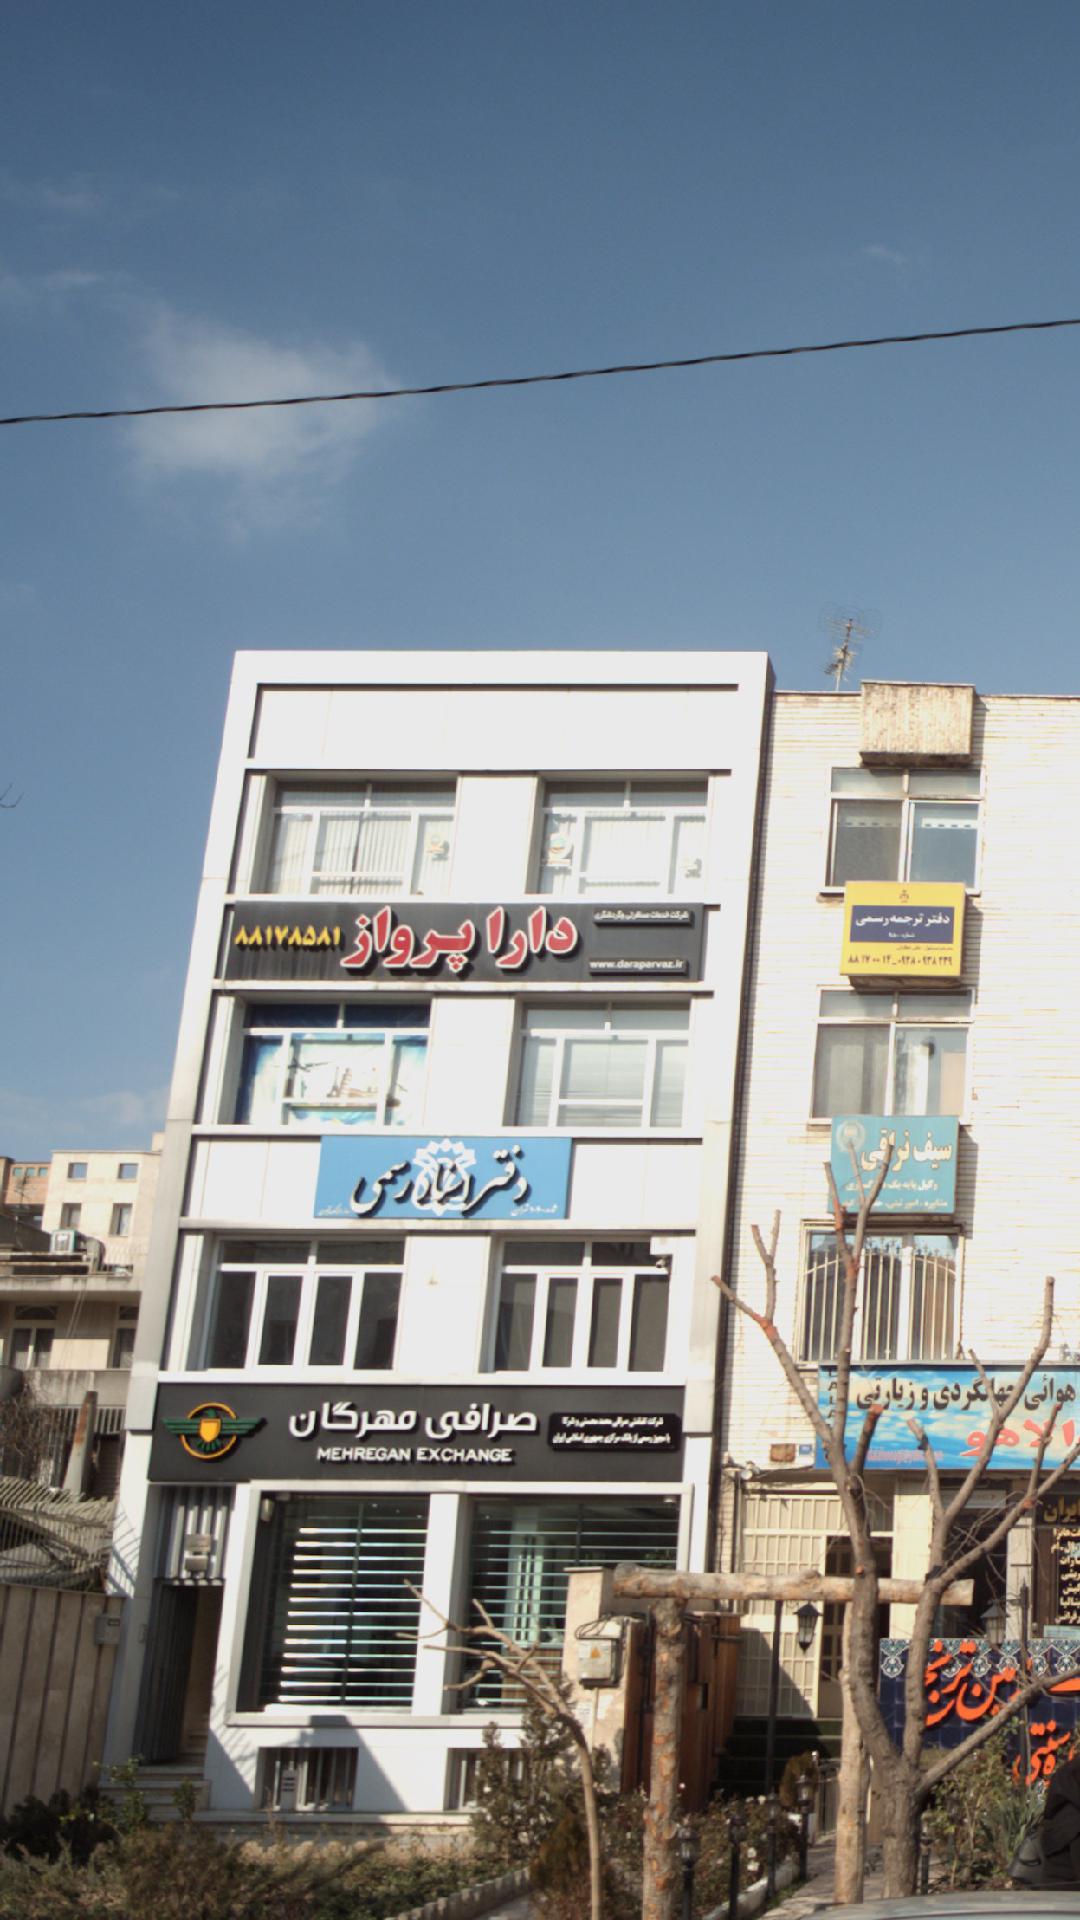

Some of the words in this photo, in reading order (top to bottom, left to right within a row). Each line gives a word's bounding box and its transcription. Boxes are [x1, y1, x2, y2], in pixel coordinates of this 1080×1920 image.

[234, 925, 341, 947] ۸۸۱۷۸۵۸۱
[487, 905, 577, 969] دارا
[855, 914, 889, 927] رسمی
[890, 912, 925, 927] ترجمه
[924, 911, 951, 928] دفتر
[341, 905, 475, 973] پرواز
[589, 959, 684, 971] www.daraparvaz.ir
[912, 1132, 952, 1169] سیف
[350, 1159, 410, 1216] رسمی
[462, 1144, 529, 1217] دفتر
[857, 1376, 916, 1412] زیارتی
[921, 1384, 929, 1412] و
[933, 1376, 1016, 1412] جهاگردی
[289, 1401, 417, 1439] مهرگان
[424, 1402, 538, 1441] صرافی
[960, 1418, 1080, 1458] الاهو
[317, 1446, 411, 1462] MEHREGAN
[416, 1447, 513, 1462] EXCHANGE
